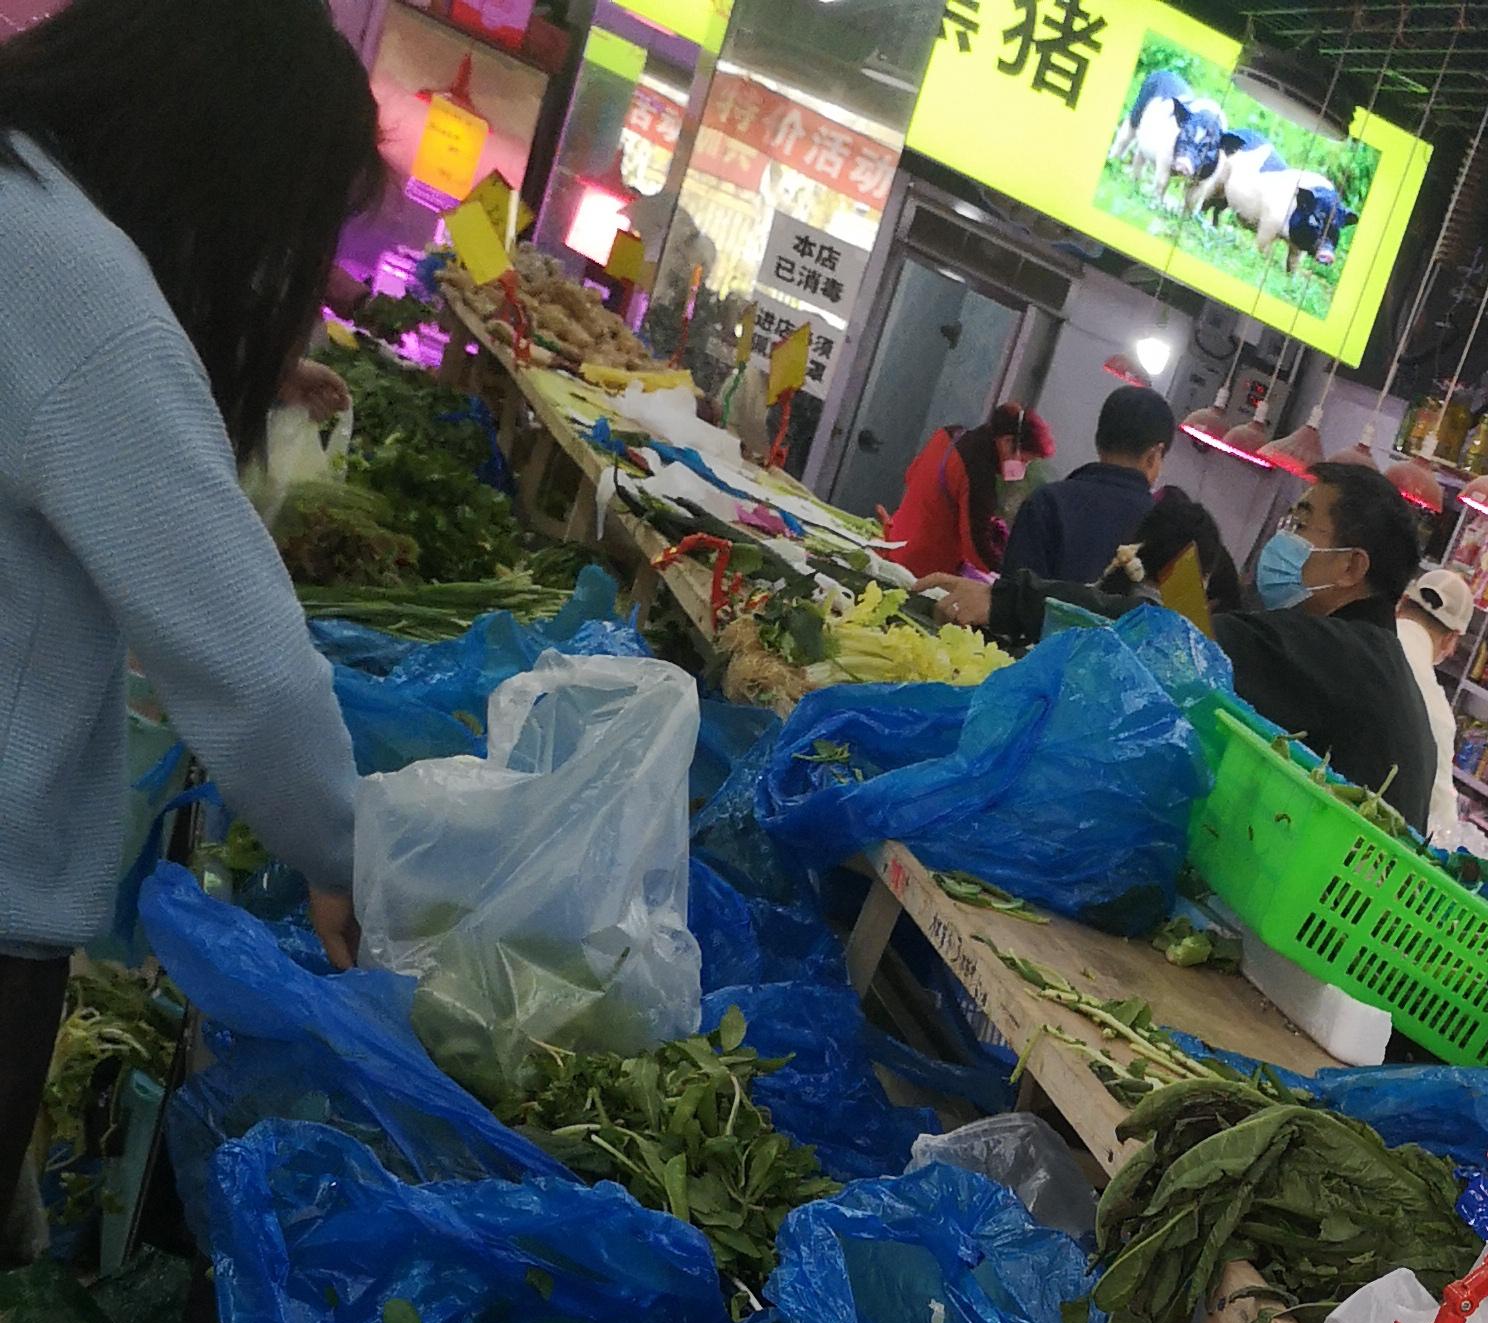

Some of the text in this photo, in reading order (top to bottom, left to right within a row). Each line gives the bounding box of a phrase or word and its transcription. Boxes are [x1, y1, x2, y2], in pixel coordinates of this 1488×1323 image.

[793, 234, 842, 272] 本店
[774, 255, 845, 304] 已消毒
[755, 309, 835, 360] 进店须
